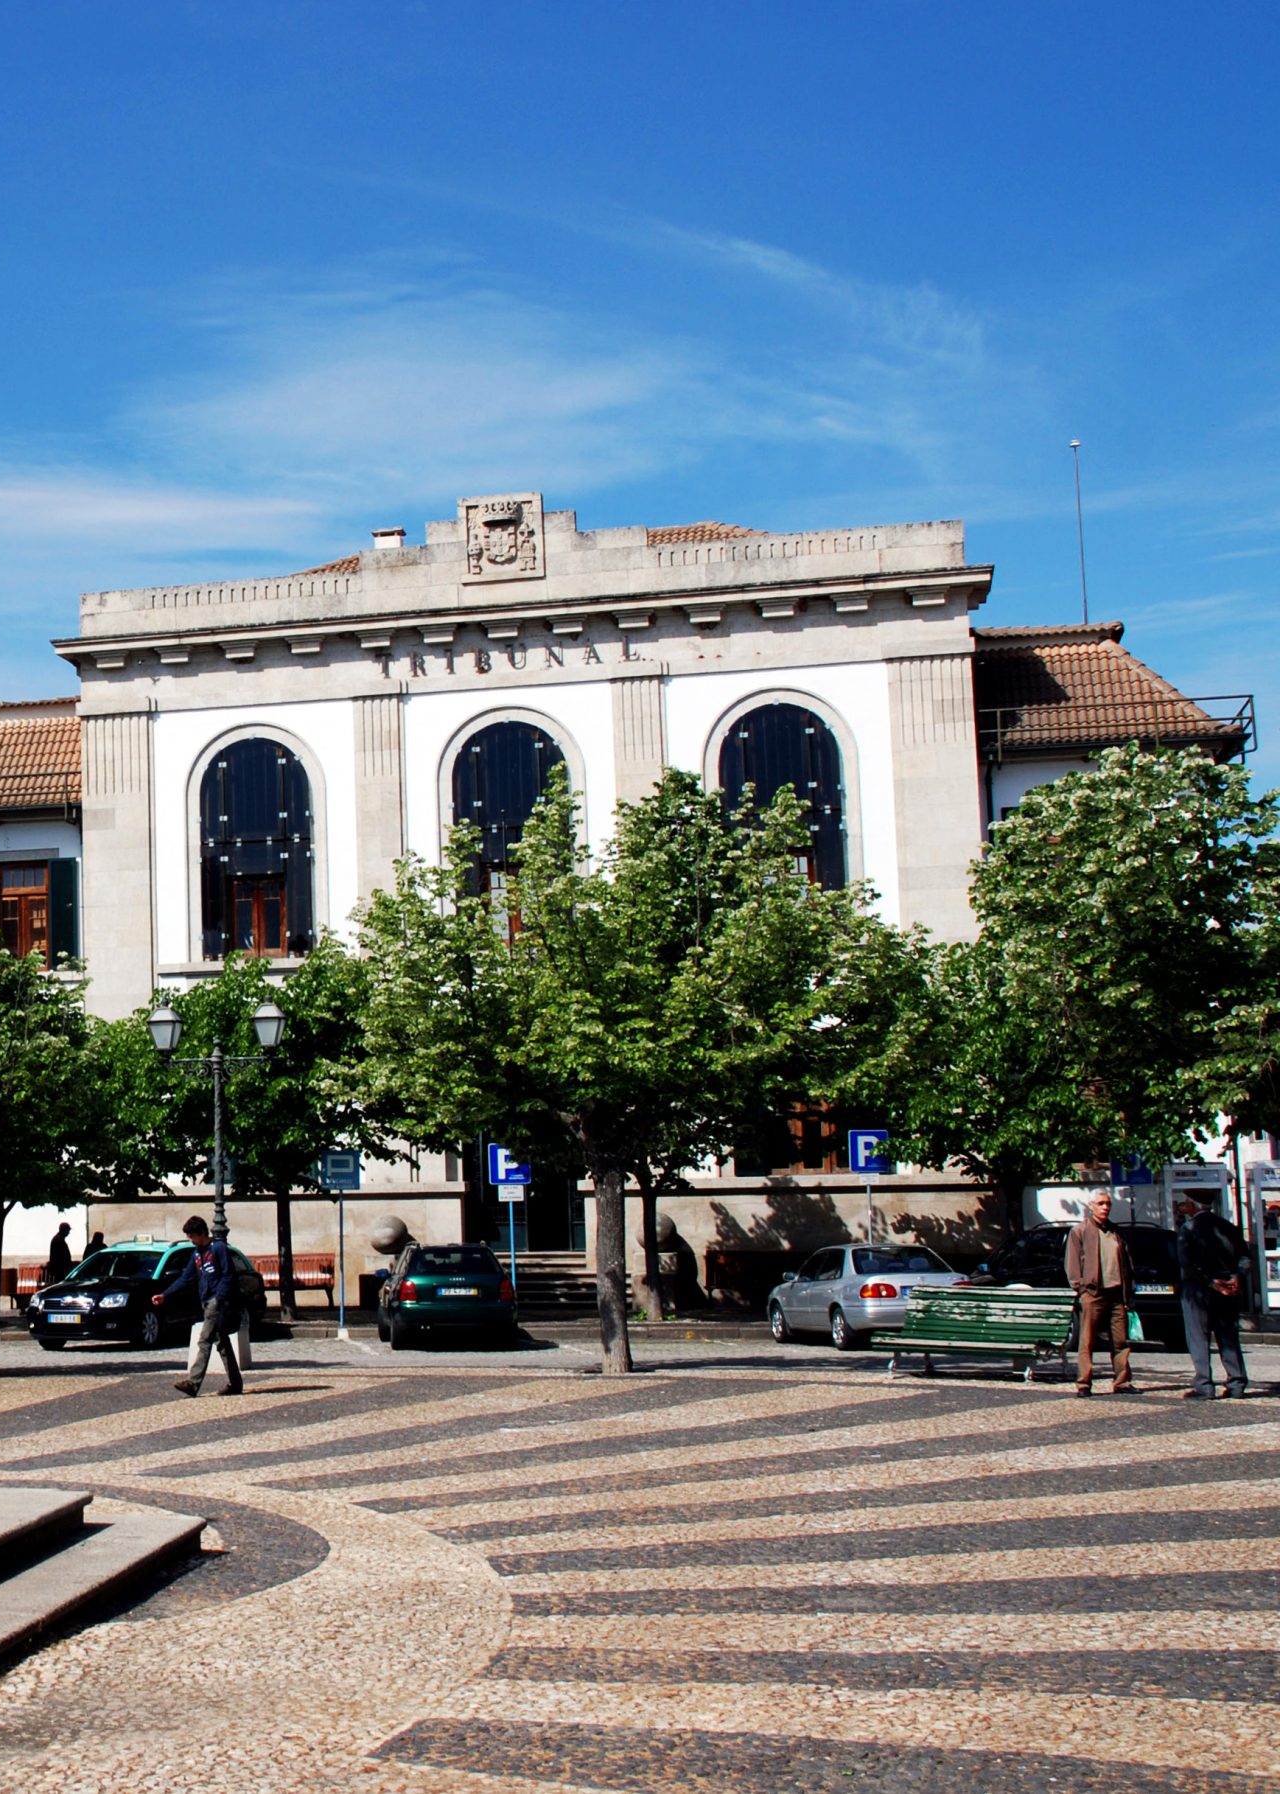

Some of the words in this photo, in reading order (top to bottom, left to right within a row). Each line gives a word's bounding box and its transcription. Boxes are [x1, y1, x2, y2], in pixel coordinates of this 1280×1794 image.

[374, 635, 640, 679] TRIBUNAL
[497, 1148, 521, 1180] P
[857, 1135, 881, 1167] P
